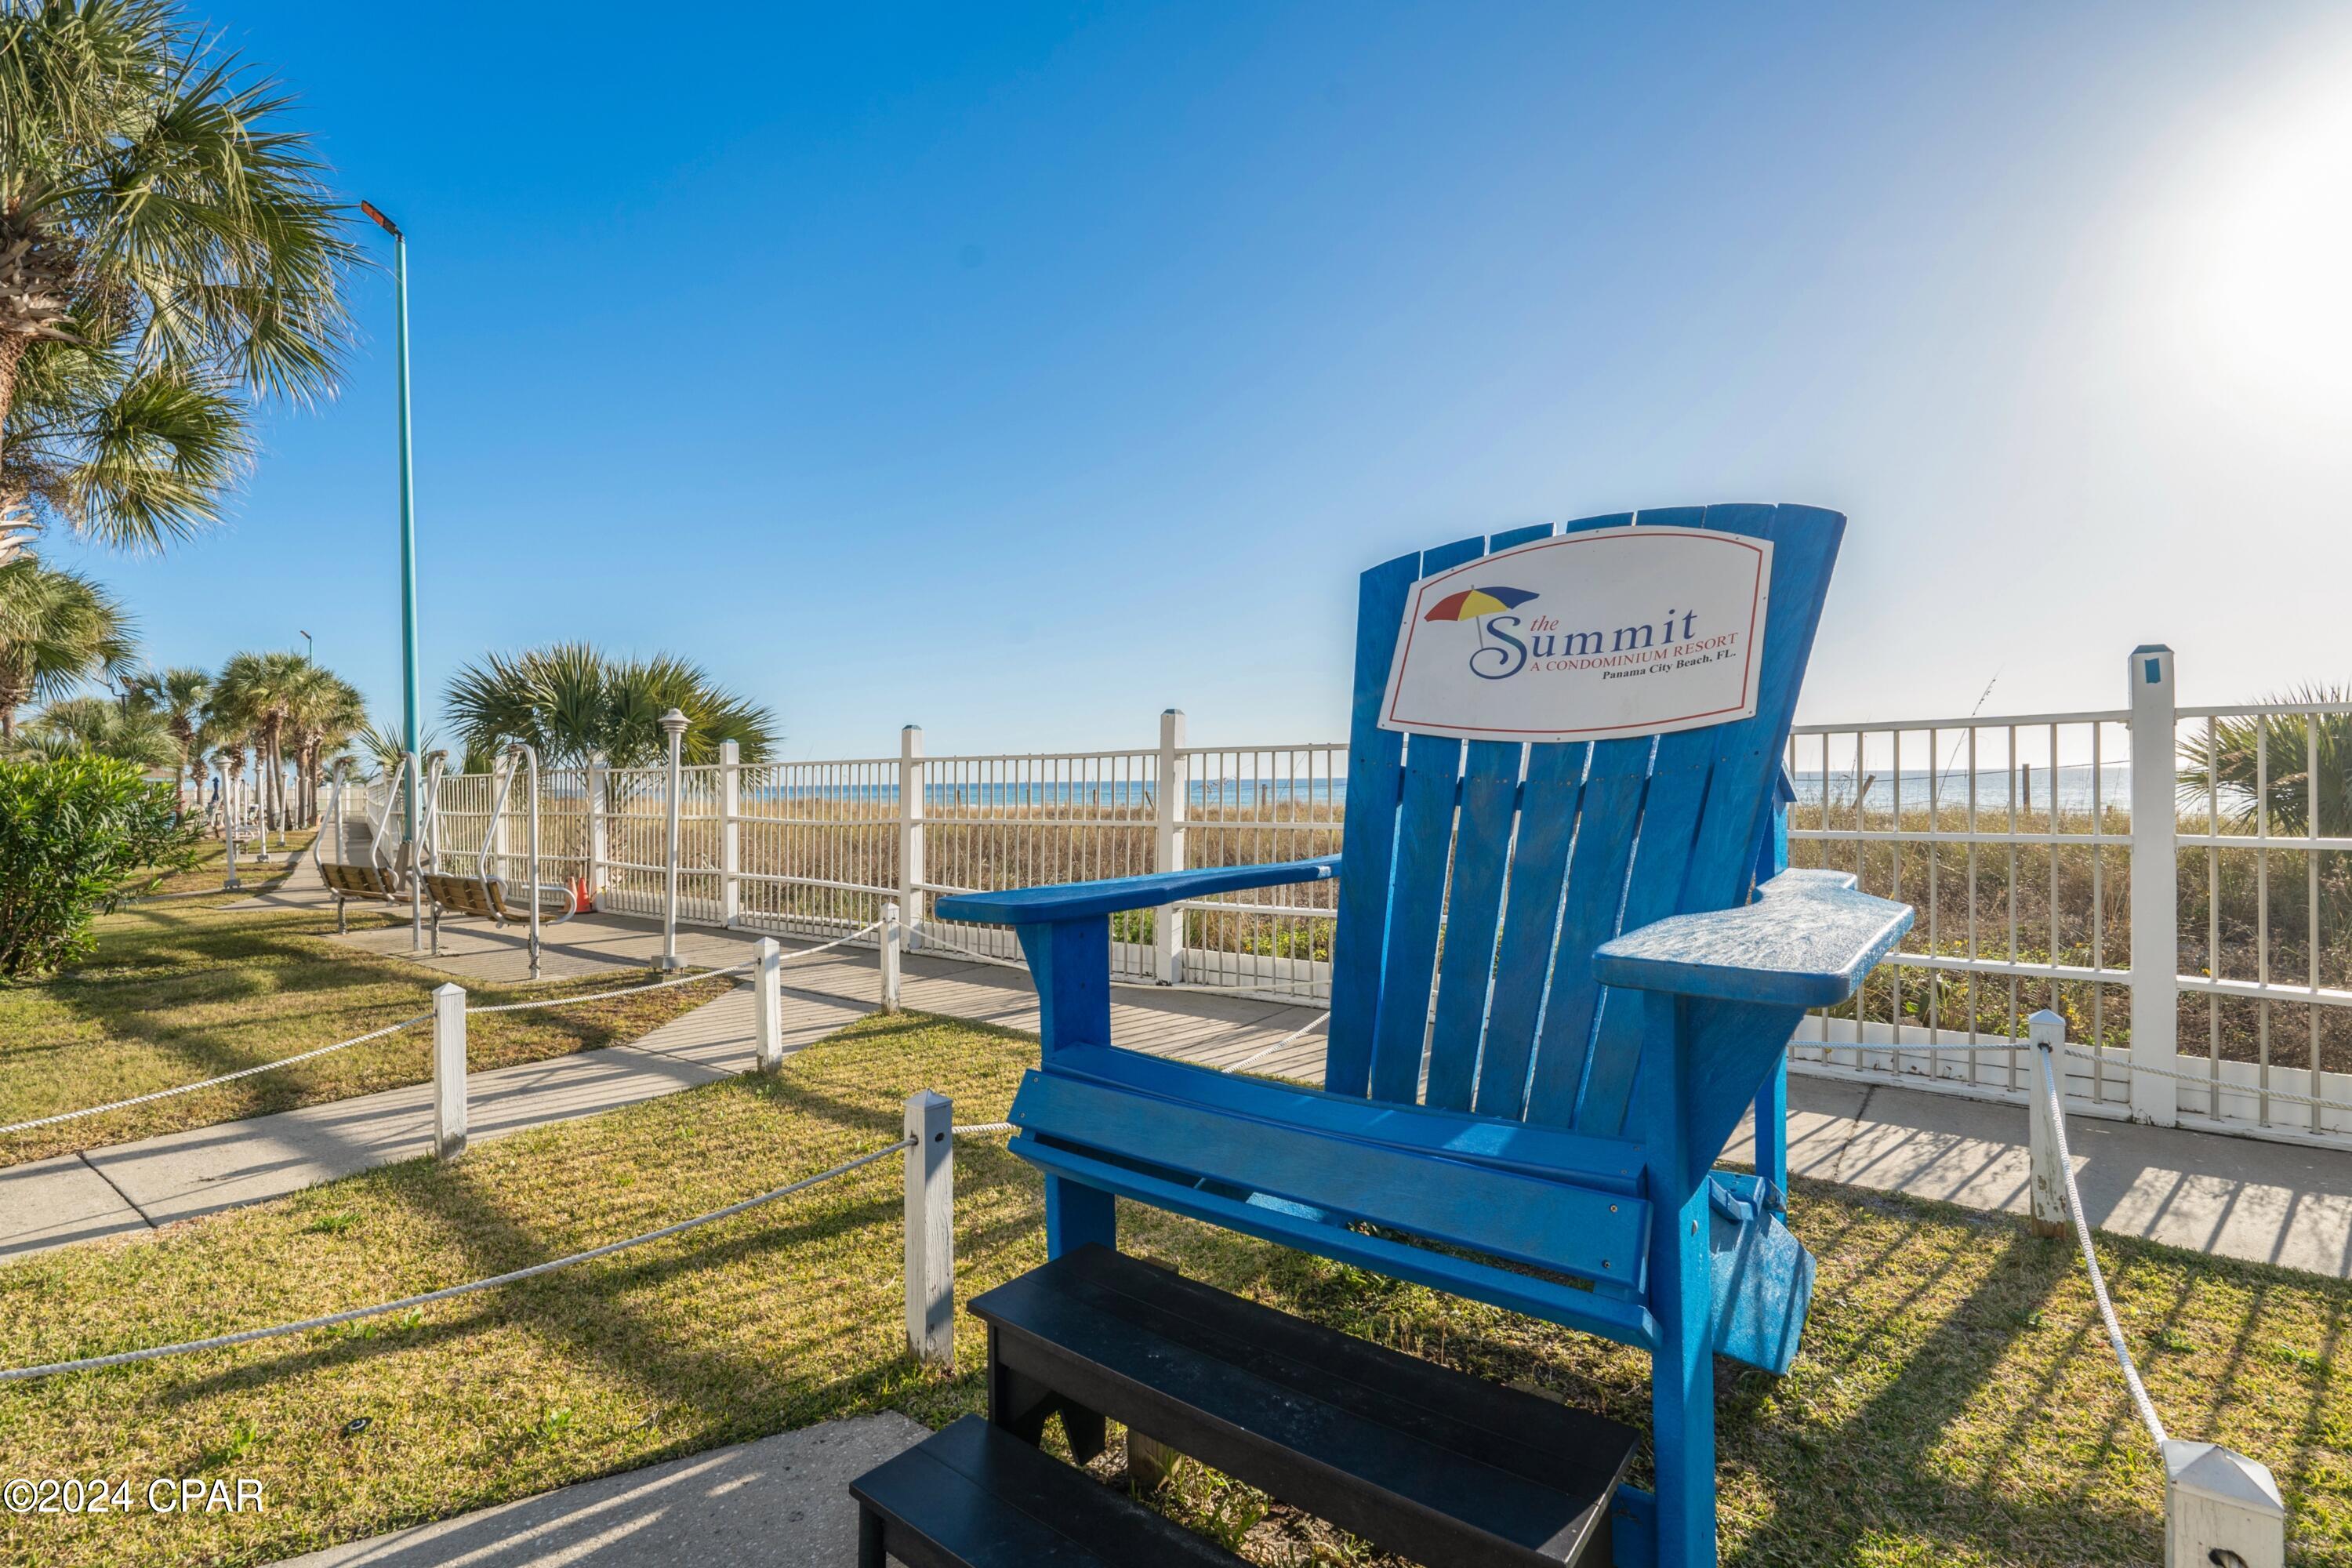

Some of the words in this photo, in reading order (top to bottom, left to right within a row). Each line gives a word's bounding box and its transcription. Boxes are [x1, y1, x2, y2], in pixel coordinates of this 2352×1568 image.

[1530, 615, 1559, 632] the
[1469, 609, 1697, 680] Summit
[1530, 662, 1541, 672] A
[1546, 648, 1669, 672] CONDOMINIUM
[1673, 632, 1739, 658] RESORT
[1602, 668, 1646, 680] Panama
[1649, 662, 1673, 673] City
[1676, 654, 1713, 670] Beach,
[1716, 649, 1737, 660] FL.
